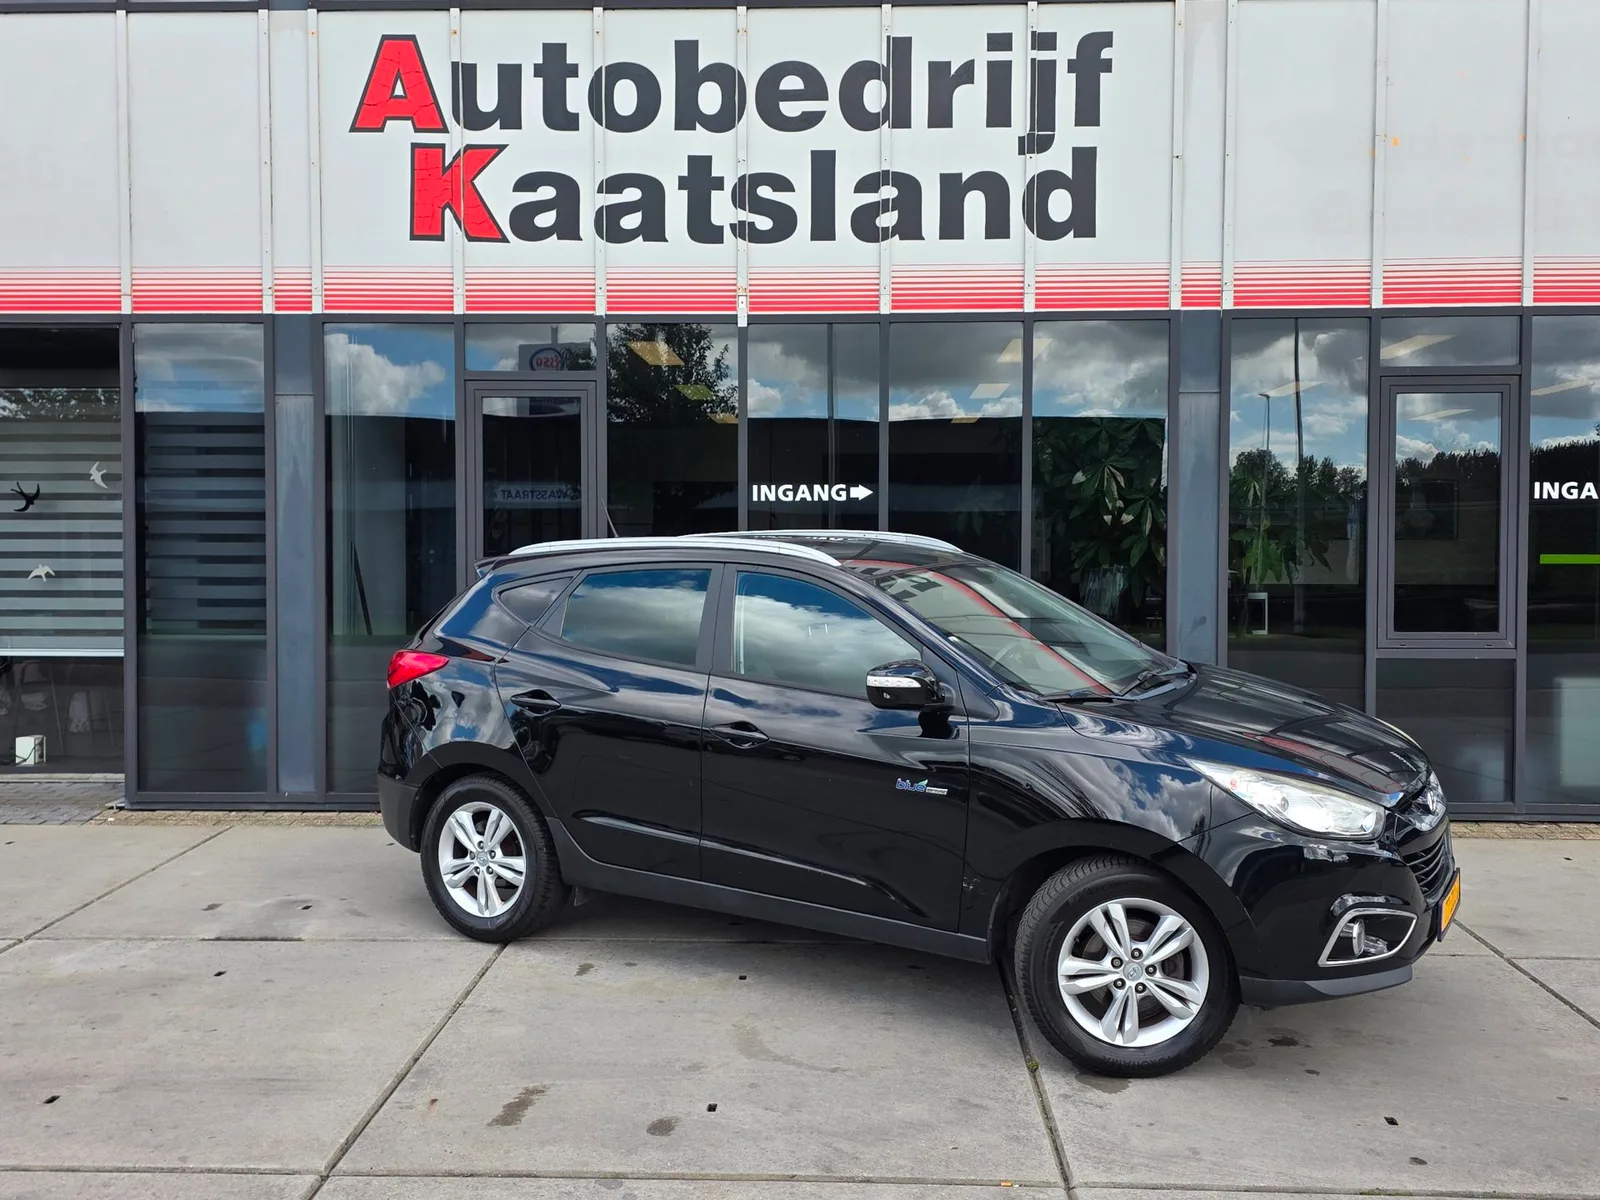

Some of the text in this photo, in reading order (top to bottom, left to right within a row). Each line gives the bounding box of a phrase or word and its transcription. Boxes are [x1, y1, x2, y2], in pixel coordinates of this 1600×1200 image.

[349, 31, 1114, 156] Autobedrijf
[409, 142, 1098, 244] Kaatsland
[752, 484, 847, 501] INGANG
[1534, 481, 1599, 499] INGA
[895, 778, 926, 792] blue
